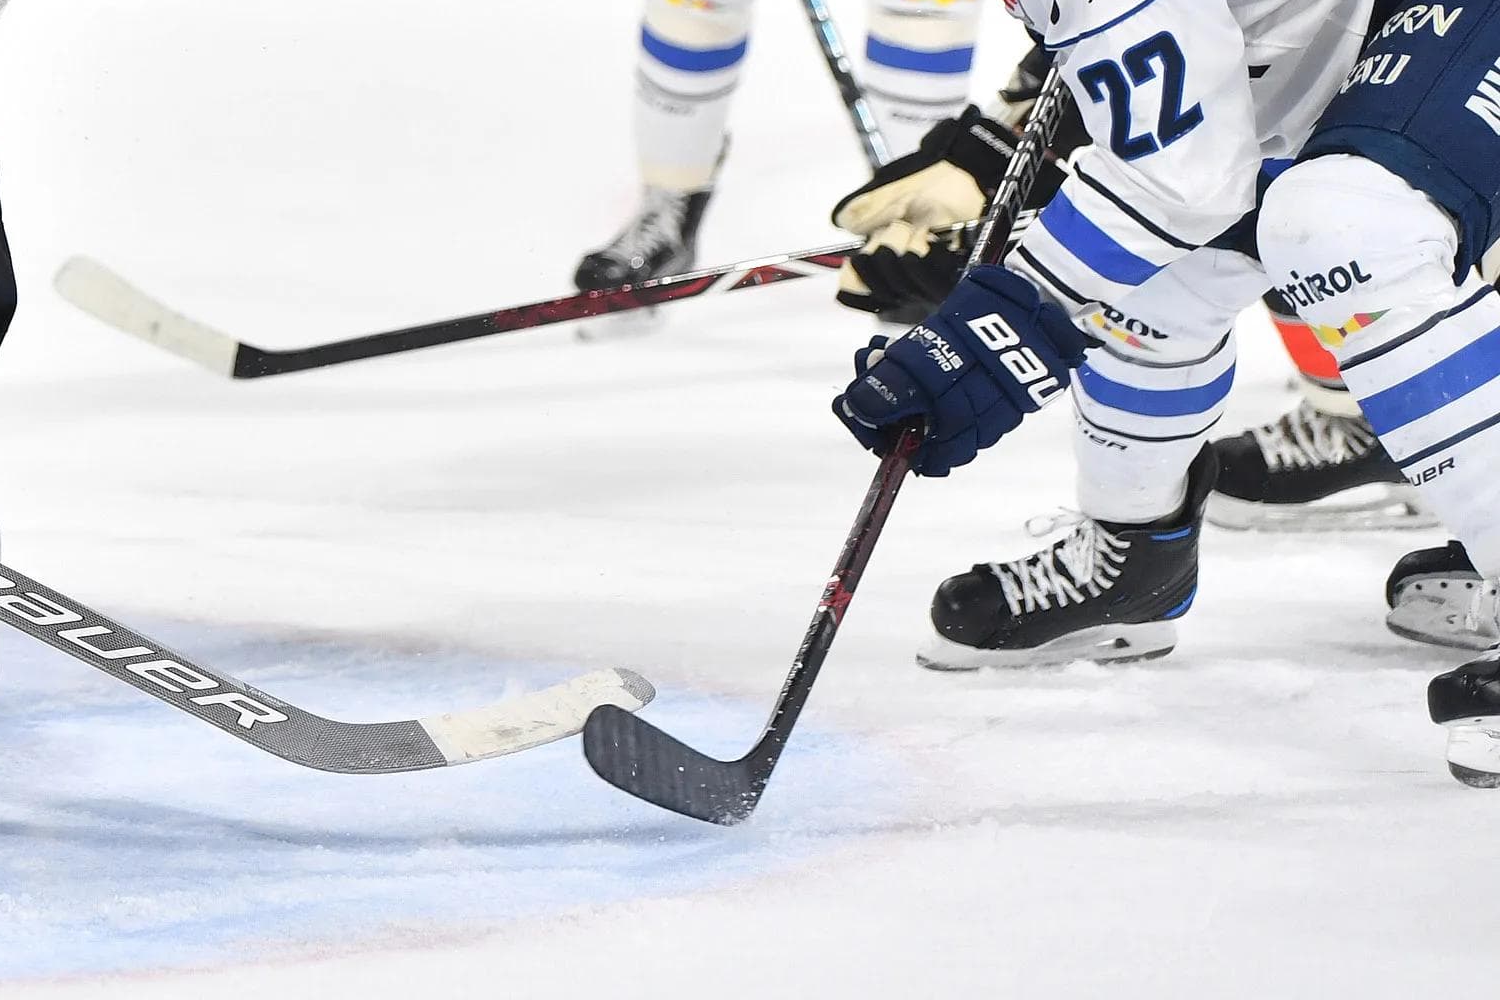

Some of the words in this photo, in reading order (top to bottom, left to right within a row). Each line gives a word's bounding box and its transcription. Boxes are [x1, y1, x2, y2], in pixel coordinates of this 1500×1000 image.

[1077, 29, 1204, 161] 22
[913, 324, 964, 370] NEXUS
[965, 312, 1065, 408] BAU
[1409, 456, 1456, 488] UER
